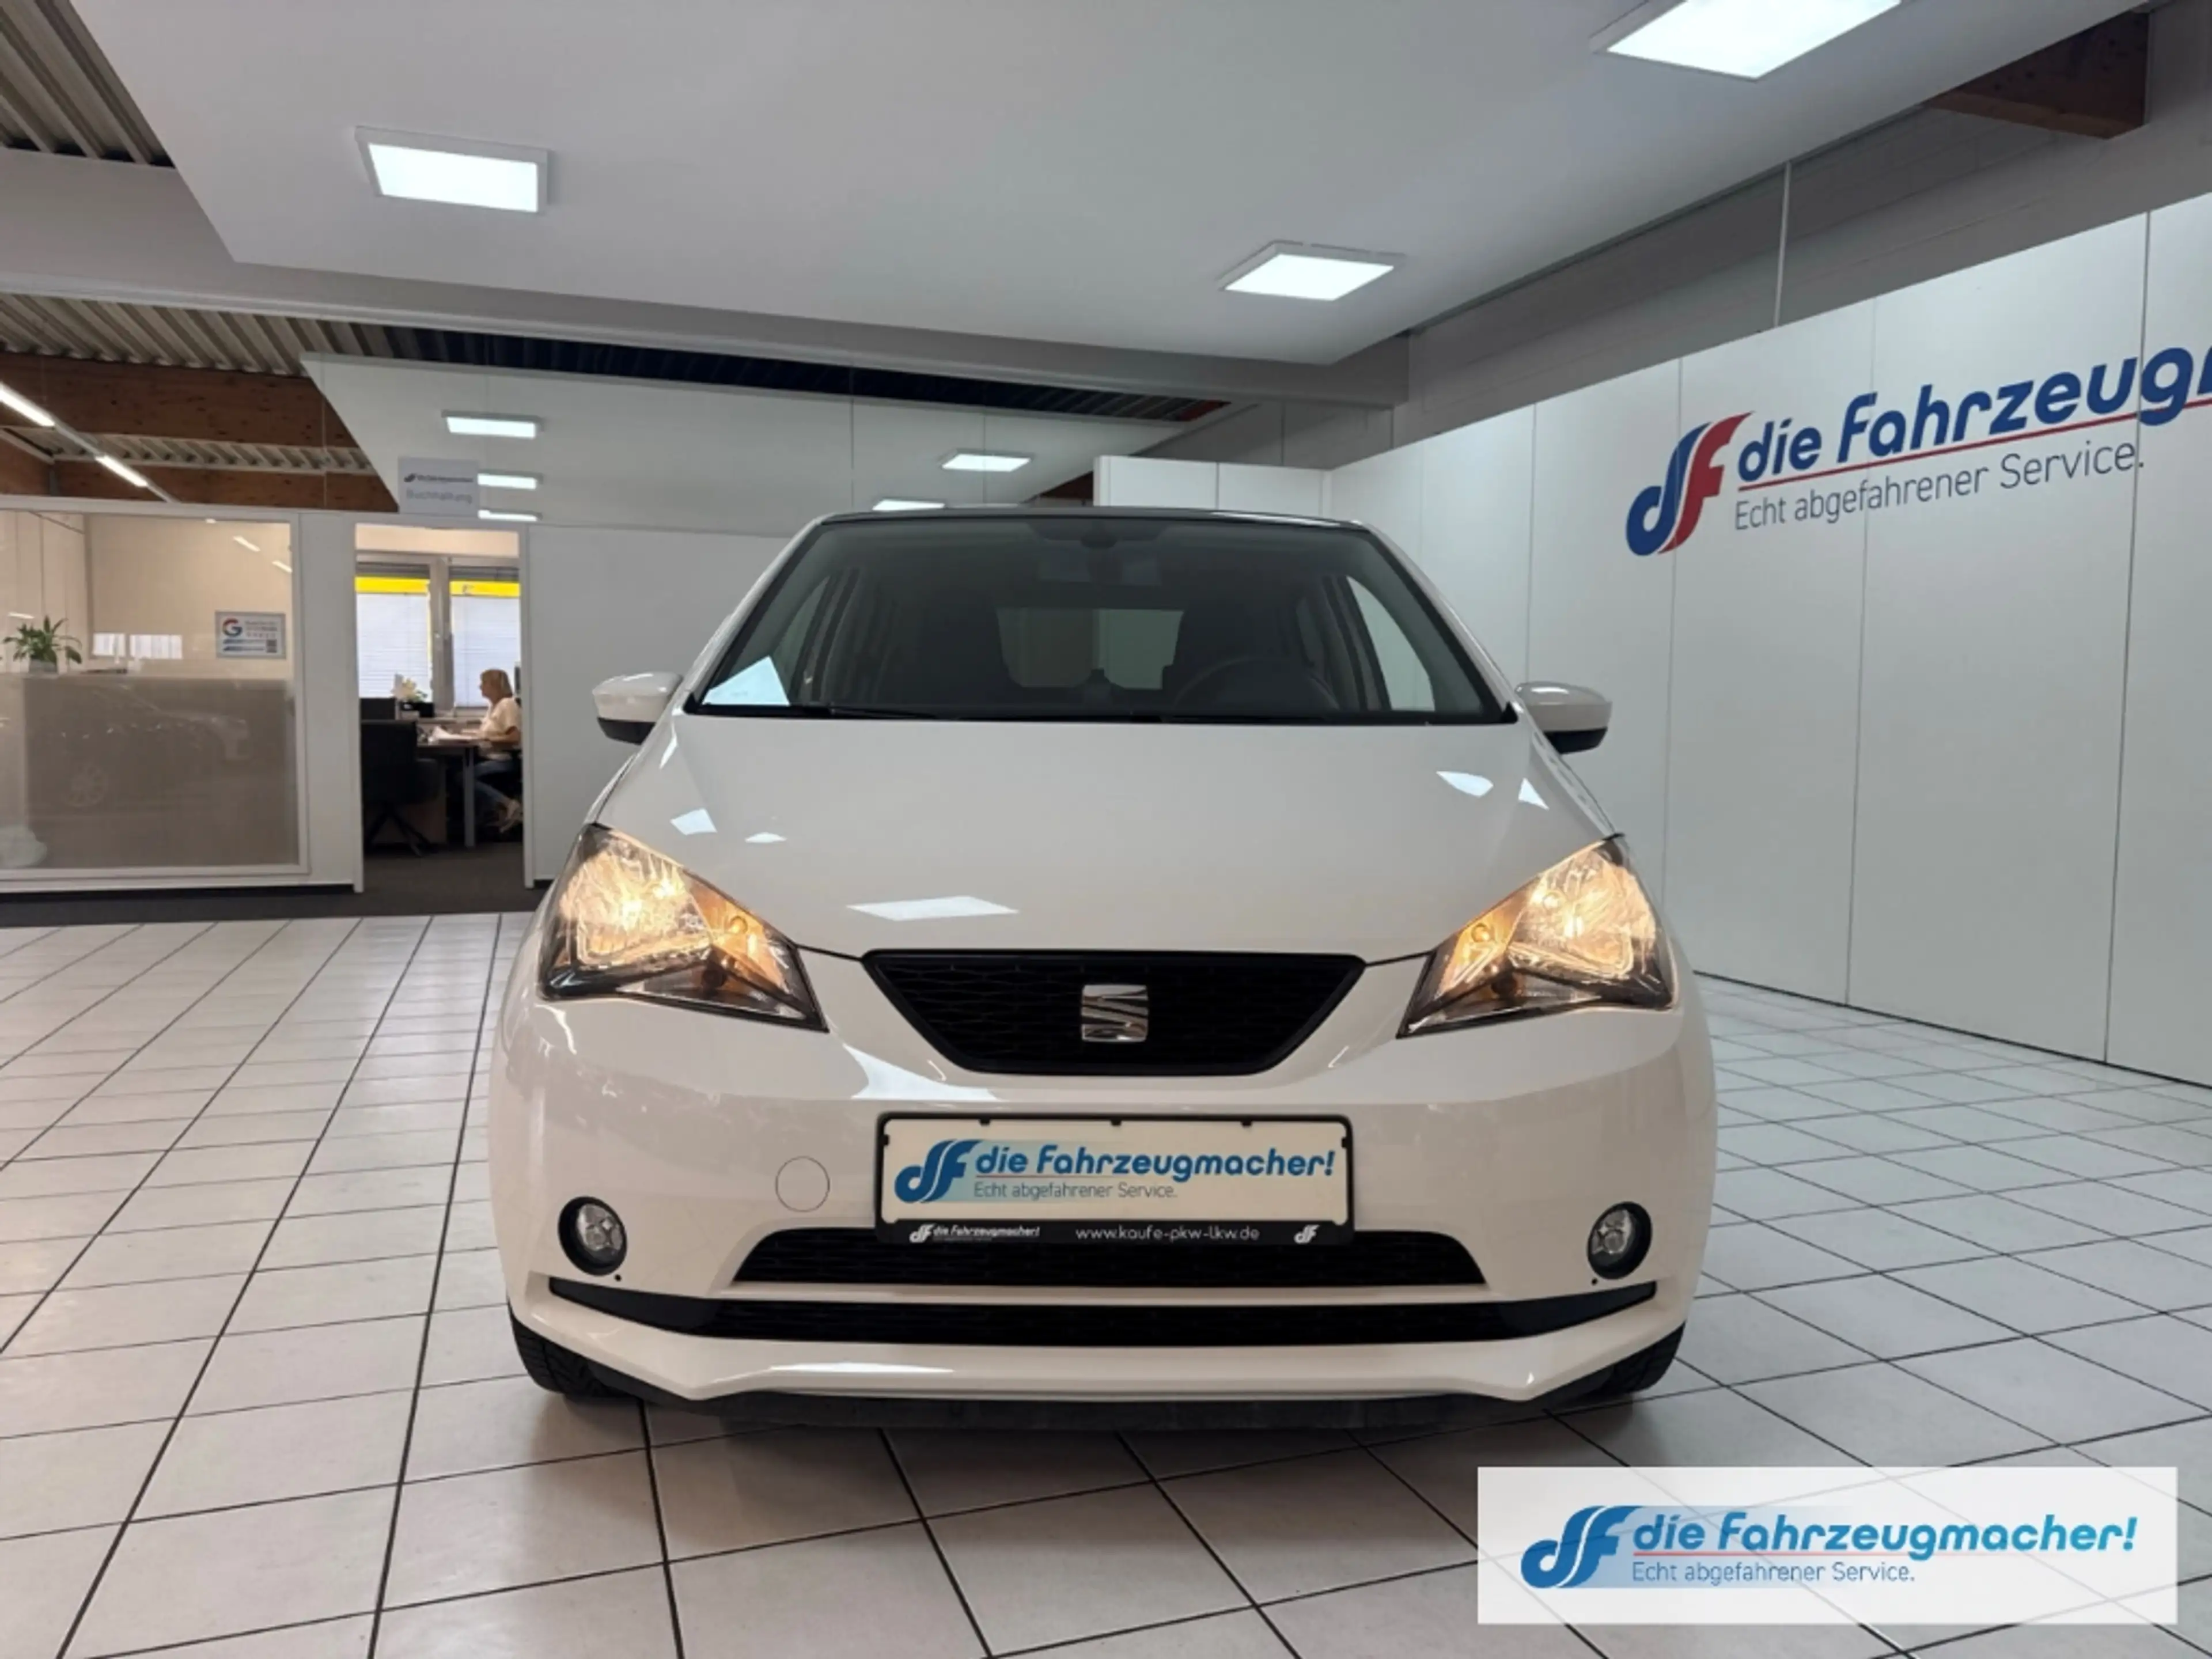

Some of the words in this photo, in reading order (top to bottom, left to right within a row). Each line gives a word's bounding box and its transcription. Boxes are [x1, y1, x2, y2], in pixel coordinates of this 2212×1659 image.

[1738, 418, 1821, 482] die
[1837, 346, 2212, 463] Fahrzeug
[1736, 497, 1786, 531] Echt
[1795, 466, 1989, 524] abgefahrener
[2000, 441, 2144, 488] Service.
[975, 1146, 1028, 1173] die
[1037, 1145, 1335, 1183] Fahrzeugmacher!
[974, 1181, 1007, 1198] Echt
[1012, 1181, 1113, 1201] abgefahrener
[1118, 1182, 1177, 1198] Service.
[1075, 1225, 1260, 1241] www.kaufe-pkw-lkw.de
